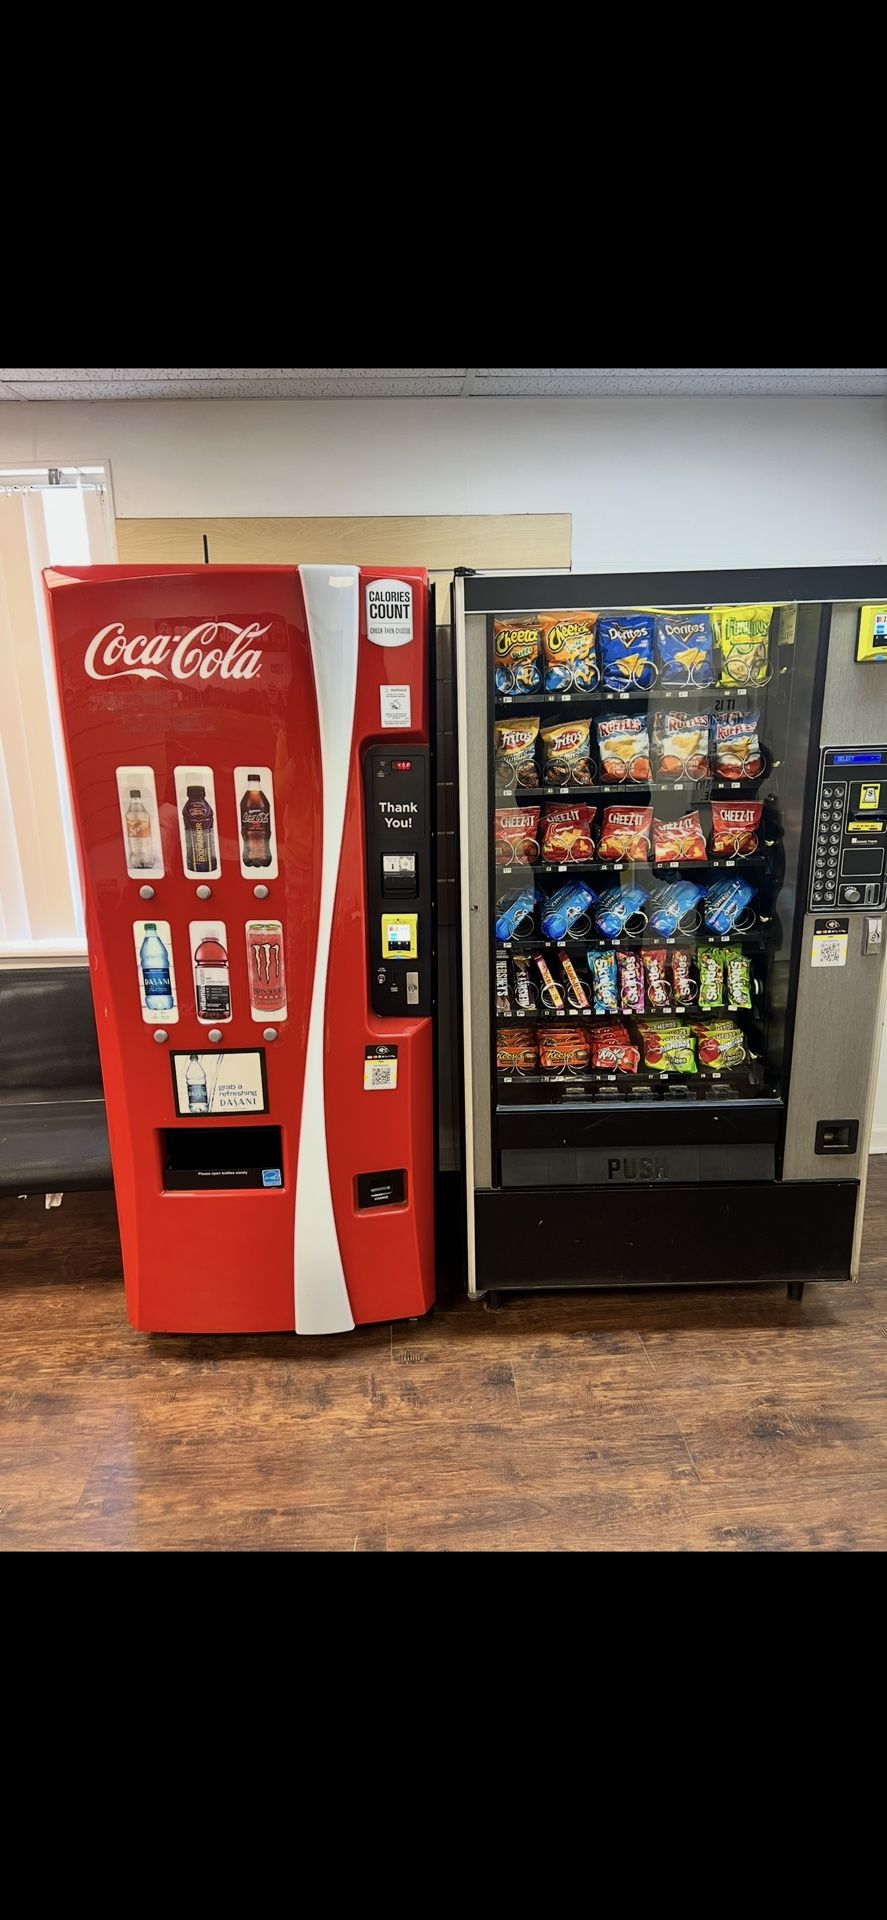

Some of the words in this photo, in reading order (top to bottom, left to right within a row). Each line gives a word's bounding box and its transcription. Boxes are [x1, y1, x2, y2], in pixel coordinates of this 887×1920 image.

[369, 590, 410, 602] CALORIES
[370, 603, 410, 619] COUNT
[370, 627, 382, 635] CHECK
[385, 627, 395, 635] THEN
[608, 626, 648, 641] Doritos
[664, 622, 706, 636] Doritos
[84, 622, 272, 681] Coca-Cola
[598, 718, 641, 737] RUFFLES
[668, 714, 709, 732] RUFFLES
[501, 730, 533, 749] Fritos
[379, 802, 418, 813] Thank
[384, 817, 413, 828] You!
[501, 815, 535, 828] CHEEZ-IT
[608, 812, 645, 826] CHEEZ-IT
[720, 809, 755, 822] CHEEZ-IT
[706, 959, 718, 1000] Skittles
[220, 1097, 256, 1107] DASANI
[607, 1157, 669, 1180] PUSH
